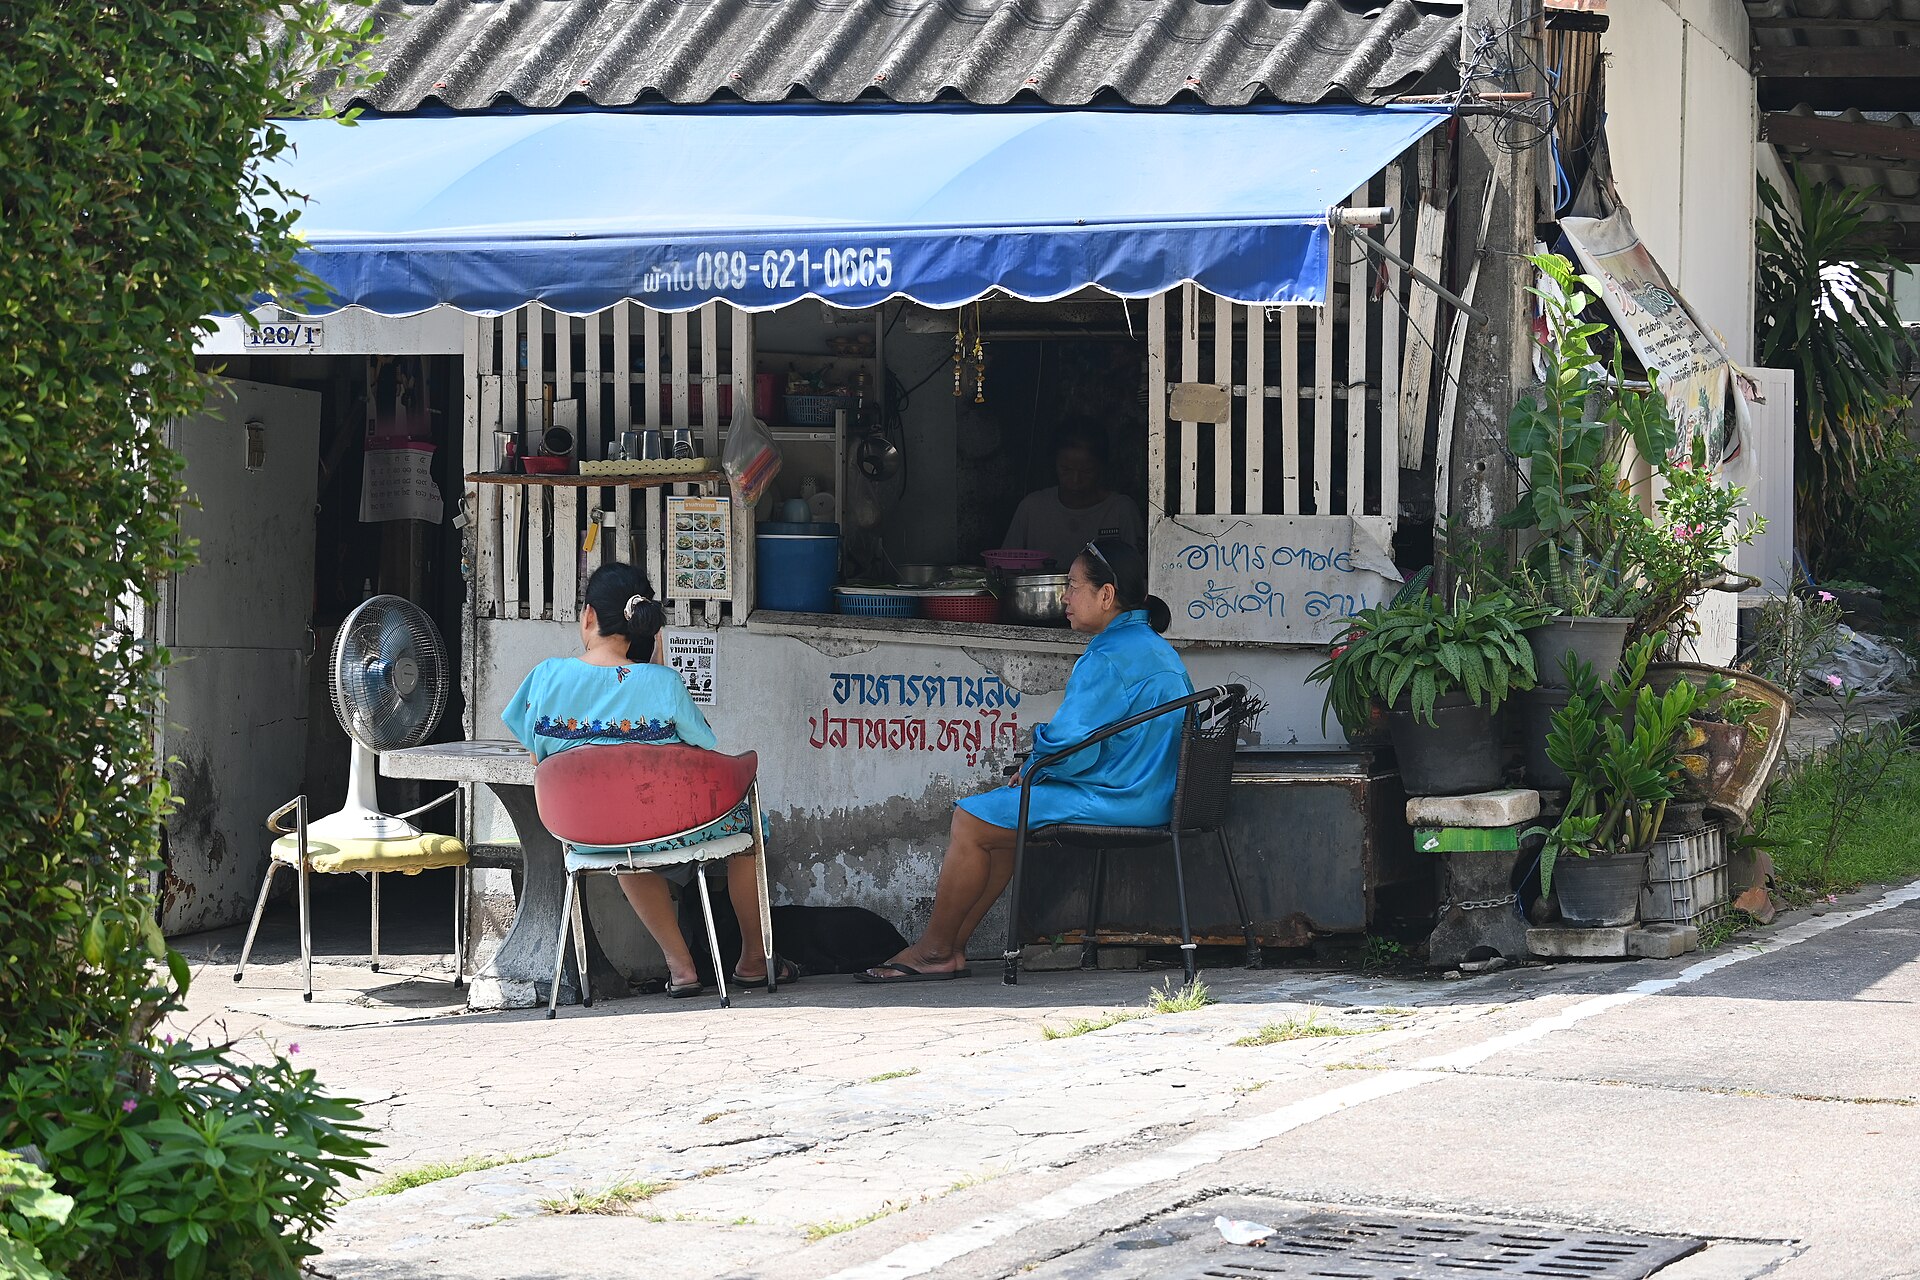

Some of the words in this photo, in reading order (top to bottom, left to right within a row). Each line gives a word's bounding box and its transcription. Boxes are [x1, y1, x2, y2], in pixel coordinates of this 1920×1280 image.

[695, 247, 893, 291] 089-621-0665
[250, 324, 315, 346] 120/1
[1187, 579, 1285, 620] ส้มตำ
